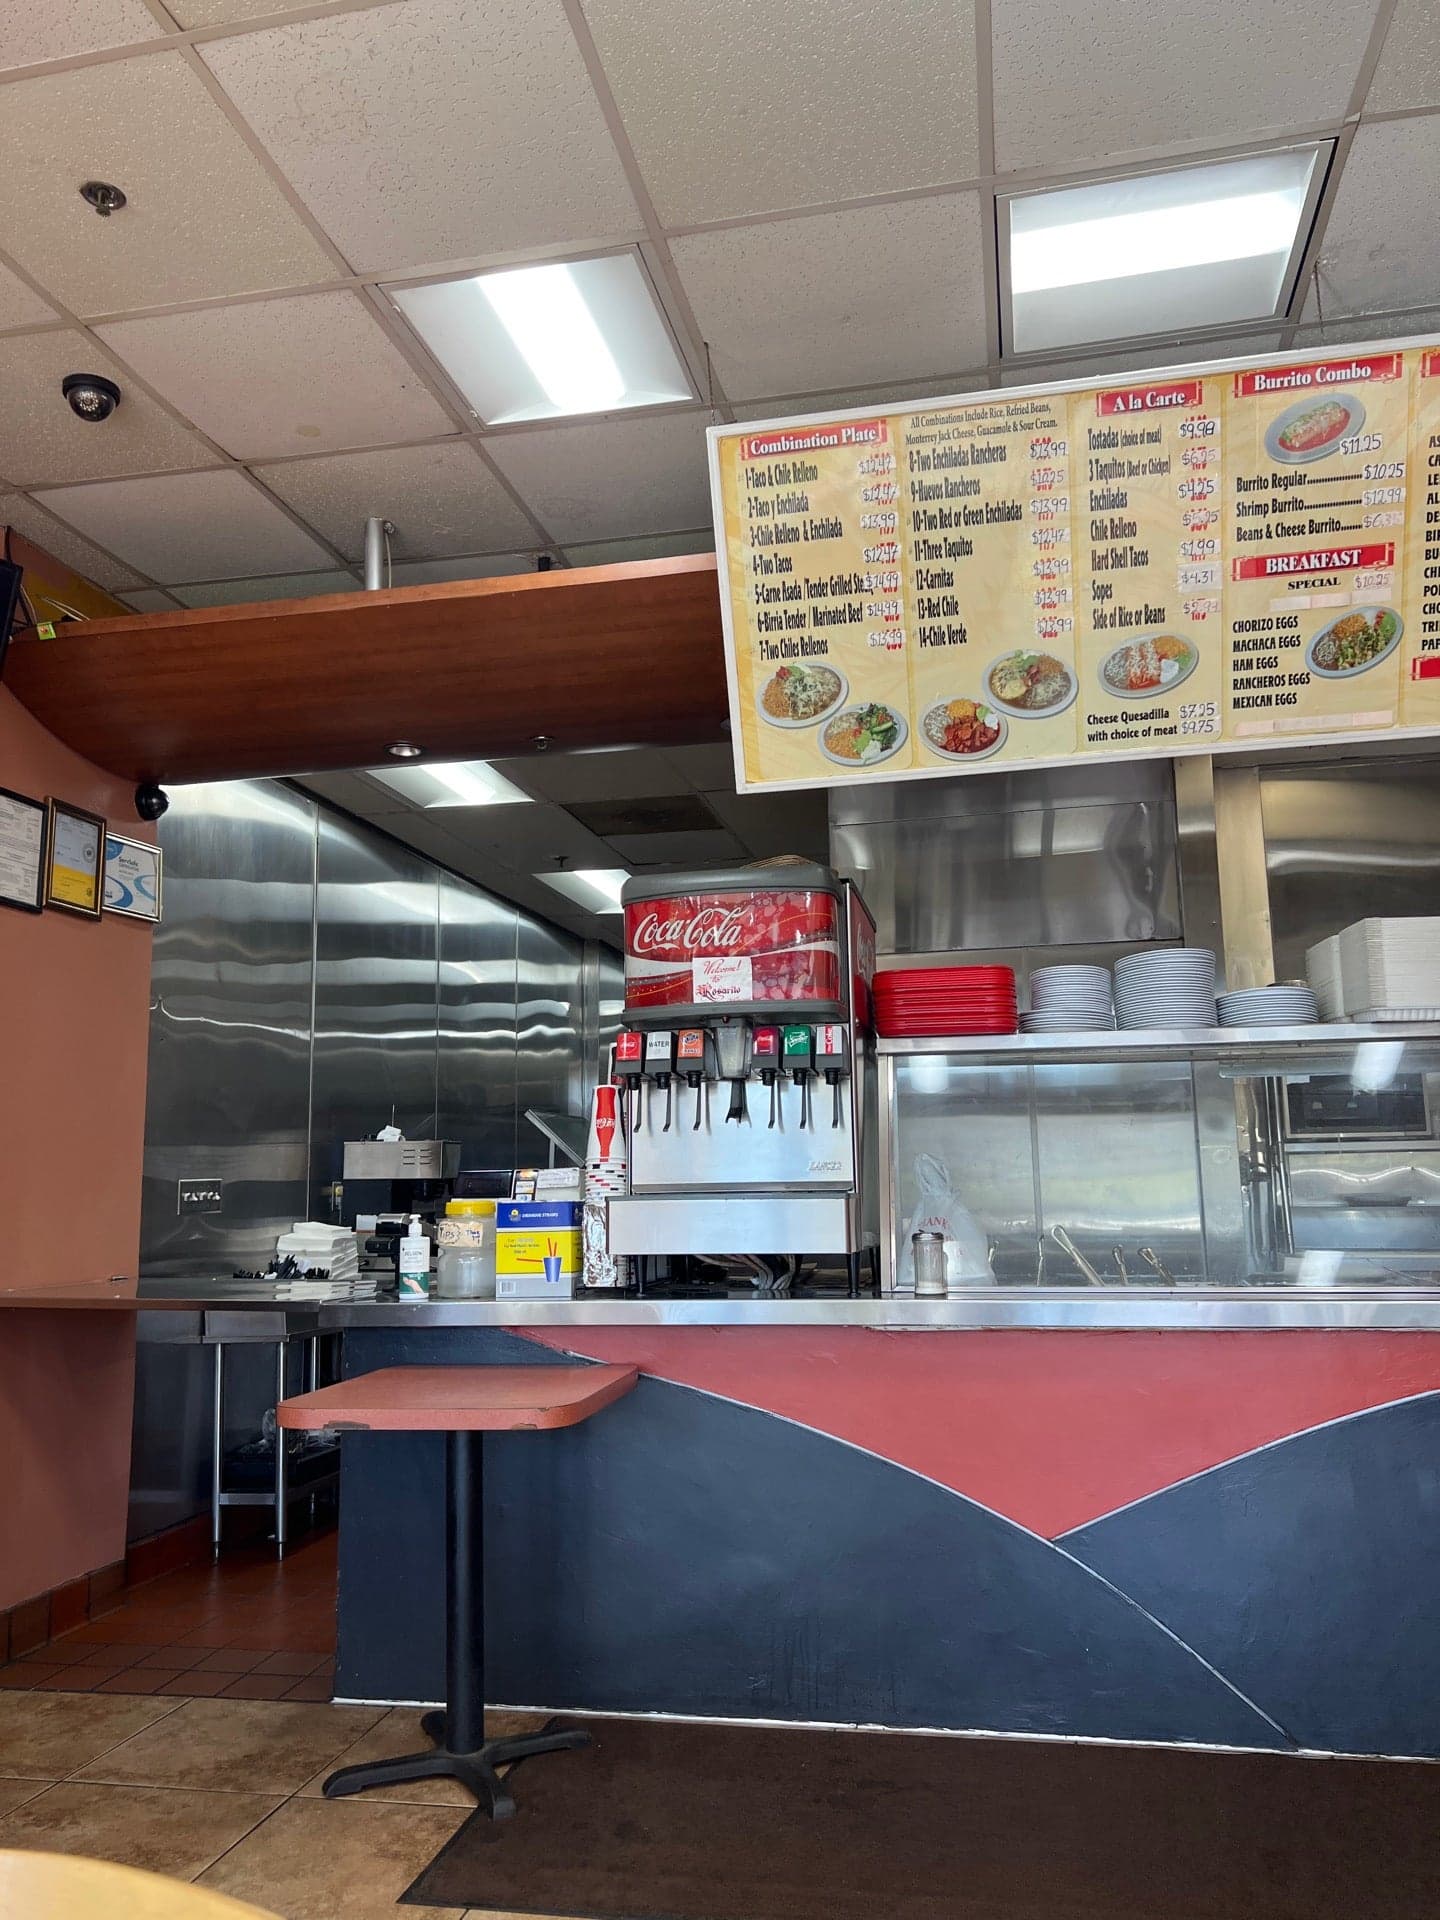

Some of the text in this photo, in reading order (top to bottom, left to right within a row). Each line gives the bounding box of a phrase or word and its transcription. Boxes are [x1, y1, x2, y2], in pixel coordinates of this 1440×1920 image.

[1254, 363, 1372, 391] Burrito Combo
[1113, 391, 1186, 412] A la Carte
[910, 416, 920, 429] All
[920, 412, 964, 428] Combinations
[965, 408, 988, 423] Include
[1006, 404, 1030, 418] Refried
[751, 427, 877, 455] Combination Plate
[906, 431, 938, 447] Monterrey
[938, 429, 951, 445] Jack
[977, 422, 1012, 437] Guacamole
[1012, 421, 1019, 432] &
[1020, 420, 1034, 432] Sour
[1088, 425, 1118, 450] Tostadas
[1140, 428, 1145, 445] of
[910, 442, 1007, 473] 8-Two Enchiladas Rancheras
[1089, 459, 1094, 482] 3
[1095, 456, 1126, 484] Taquitos
[1142, 462, 1147, 476] or
[745, 461, 818, 489] 1-Taco & Chile Relleno
[1236, 475, 1269, 493] Burrito
[910, 475, 981, 503] 9-Huevos Rancheros
[1090, 487, 1128, 512] Enchiladas
[748, 490, 809, 520] 2-Taco y Enchilada
[912, 500, 1022, 533] 10-Two Red or Green Enchiladas
[1236, 501, 1269, 518] Shrimp
[750, 515, 843, 547] 3-Chile Relleno & Enchilada
[1090, 517, 1137, 542] Chile Relleno
[1236, 526, 1263, 542] Beans
[1266, 524, 1272, 539] &
[1275, 521, 1306, 538] Cheese
[914, 536, 973, 562] 11-Three Taquitos
[1091, 546, 1148, 571] Hard Shell Tacos
[753, 552, 793, 576] 4-Two Tacos
[1266, 550, 1362, 574] BREAKFAST
[755, 582, 781, 605] 5-Carne
[782, 579, 802, 601] Asada
[830, 573, 853, 598] Grilled
[916, 567, 954, 591] 12-Carnitas
[1182, 569, 1213, 584] $4.31
[1288, 577, 1341, 590] SPECIAL
[1092, 579, 1112, 605] Sopes
[758, 611, 783, 633] 6-Birria
[784, 609, 806, 631] Tender
[812, 604, 846, 627] Marinated
[848, 602, 864, 623] Beef
[917, 595, 959, 620] 13-Red Chile
[1092, 604, 1165, 630] Side of Rice or Beans
[919, 623, 968, 648] 14-Chile Verde
[1232, 616, 1298, 633] CHORIZO EGGS
[759, 635, 828, 661] 7-Two Chiles Rellenos
[1233, 635, 1301, 652] MACHACA EGGS
[1233, 656, 1278, 671] HAM EGGS
[1233, 672, 1310, 690] RANCHEROS EGGS
[1233, 692, 1297, 709] MEXICAN EGGS
[1087, 708, 1169, 726] Cheese Quesadilla
[1088, 725, 1178, 742] with choice of meat
[633, 906, 746, 953] Coca-Cola
[648, 1040, 669, 1048] WATER
